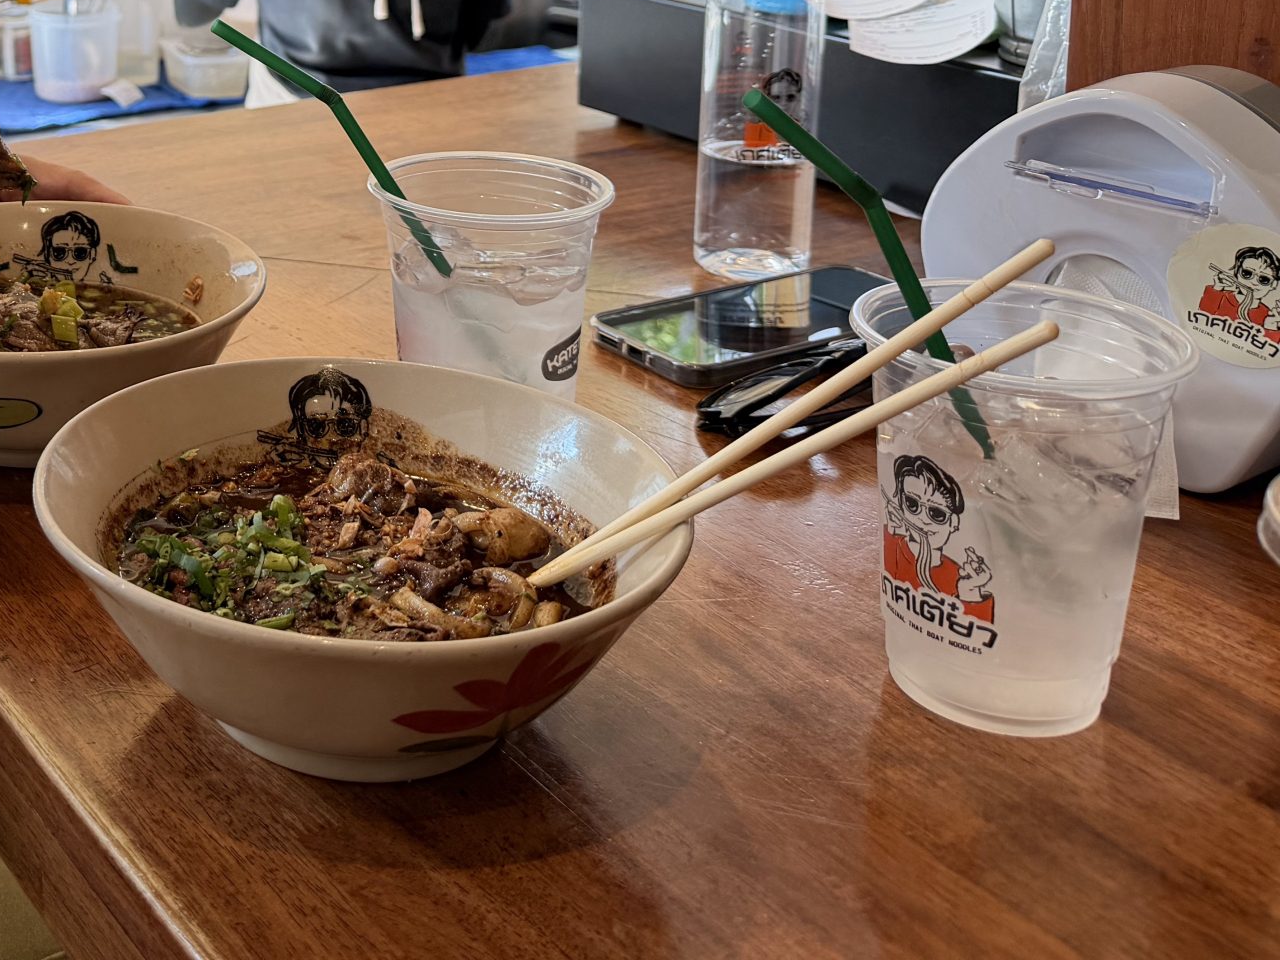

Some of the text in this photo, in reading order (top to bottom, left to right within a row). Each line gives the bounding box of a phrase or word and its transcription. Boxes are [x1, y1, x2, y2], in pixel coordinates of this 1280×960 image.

[1187, 311, 1279, 358] เกศเตี๋ยว
[1193, 326, 1215, 339] ORIGINAL
[1218, 337, 1229, 345] THAI
[1246, 350, 1267, 360] NOODLES
[546, 339, 579, 372] KATE
[908, 620, 923, 633] THAI
[926, 630, 944, 643] BOAT
[948, 639, 983, 655] NOODLES
